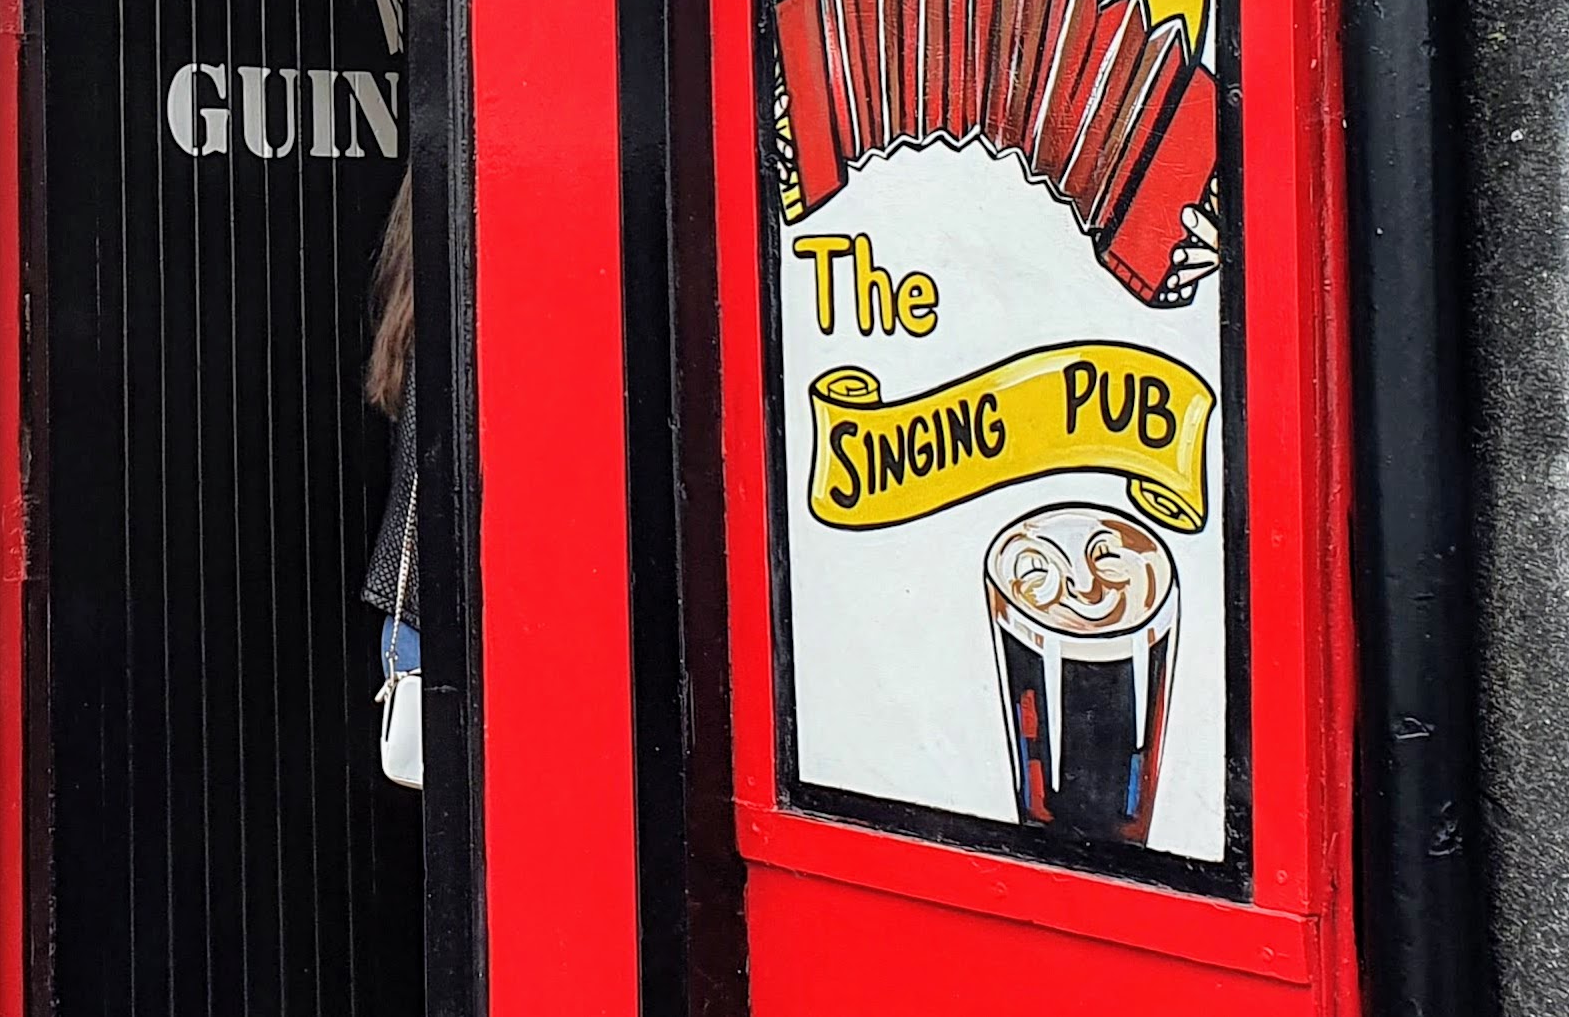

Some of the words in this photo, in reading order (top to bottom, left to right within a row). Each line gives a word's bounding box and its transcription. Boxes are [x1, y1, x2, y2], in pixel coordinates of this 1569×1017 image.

[167, 63, 399, 158] GUIN
[793, 233, 939, 336] The
[829, 393, 1006, 509] SINGING
[1063, 360, 1177, 449] PUB
